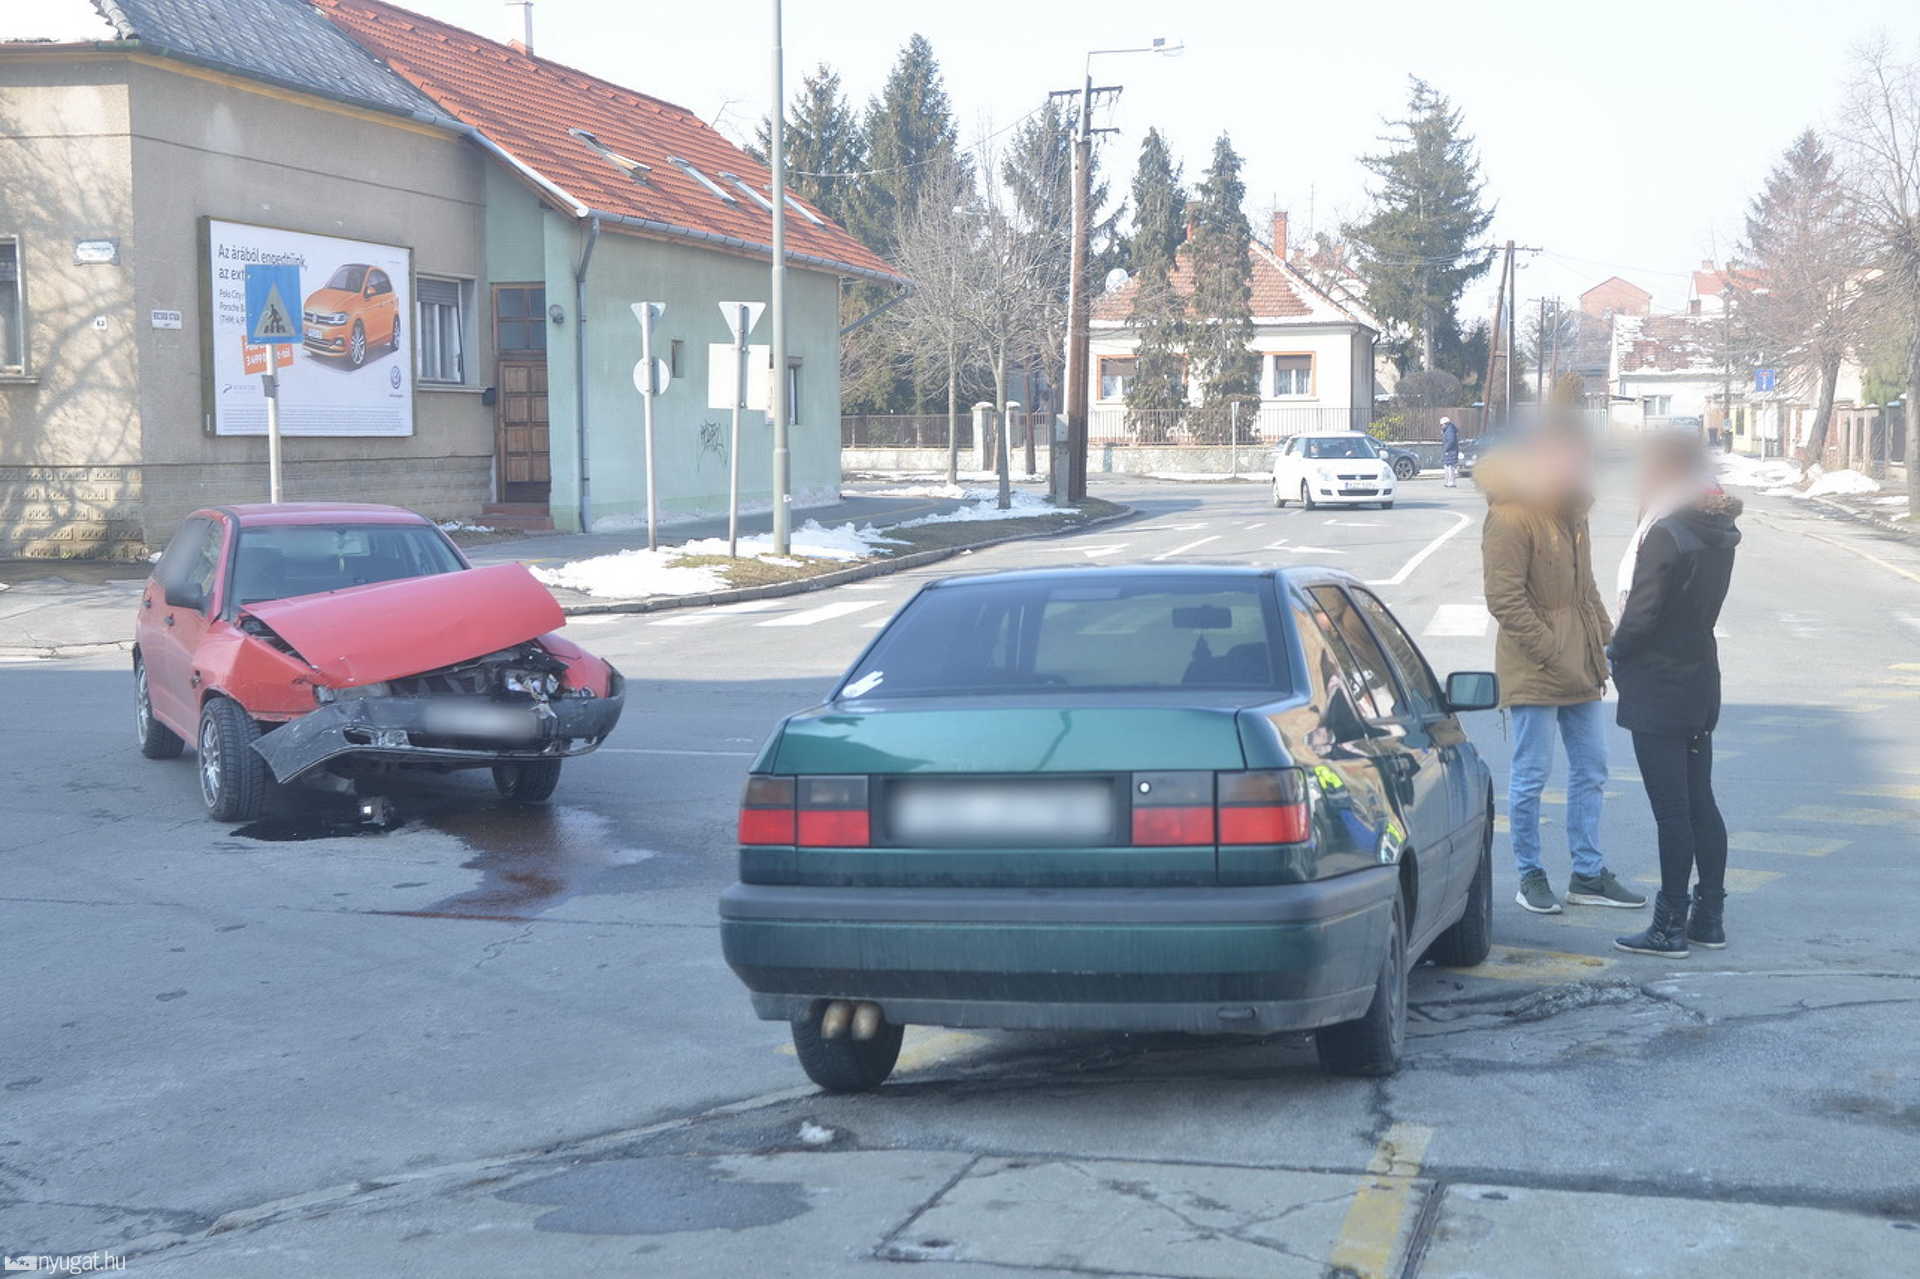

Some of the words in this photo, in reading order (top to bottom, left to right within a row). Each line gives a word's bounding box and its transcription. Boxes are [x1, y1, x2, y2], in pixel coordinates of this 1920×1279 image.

[218, 244, 229, 259] Az
[231, 245, 259, 262] árából
[219, 267, 229, 280] az
